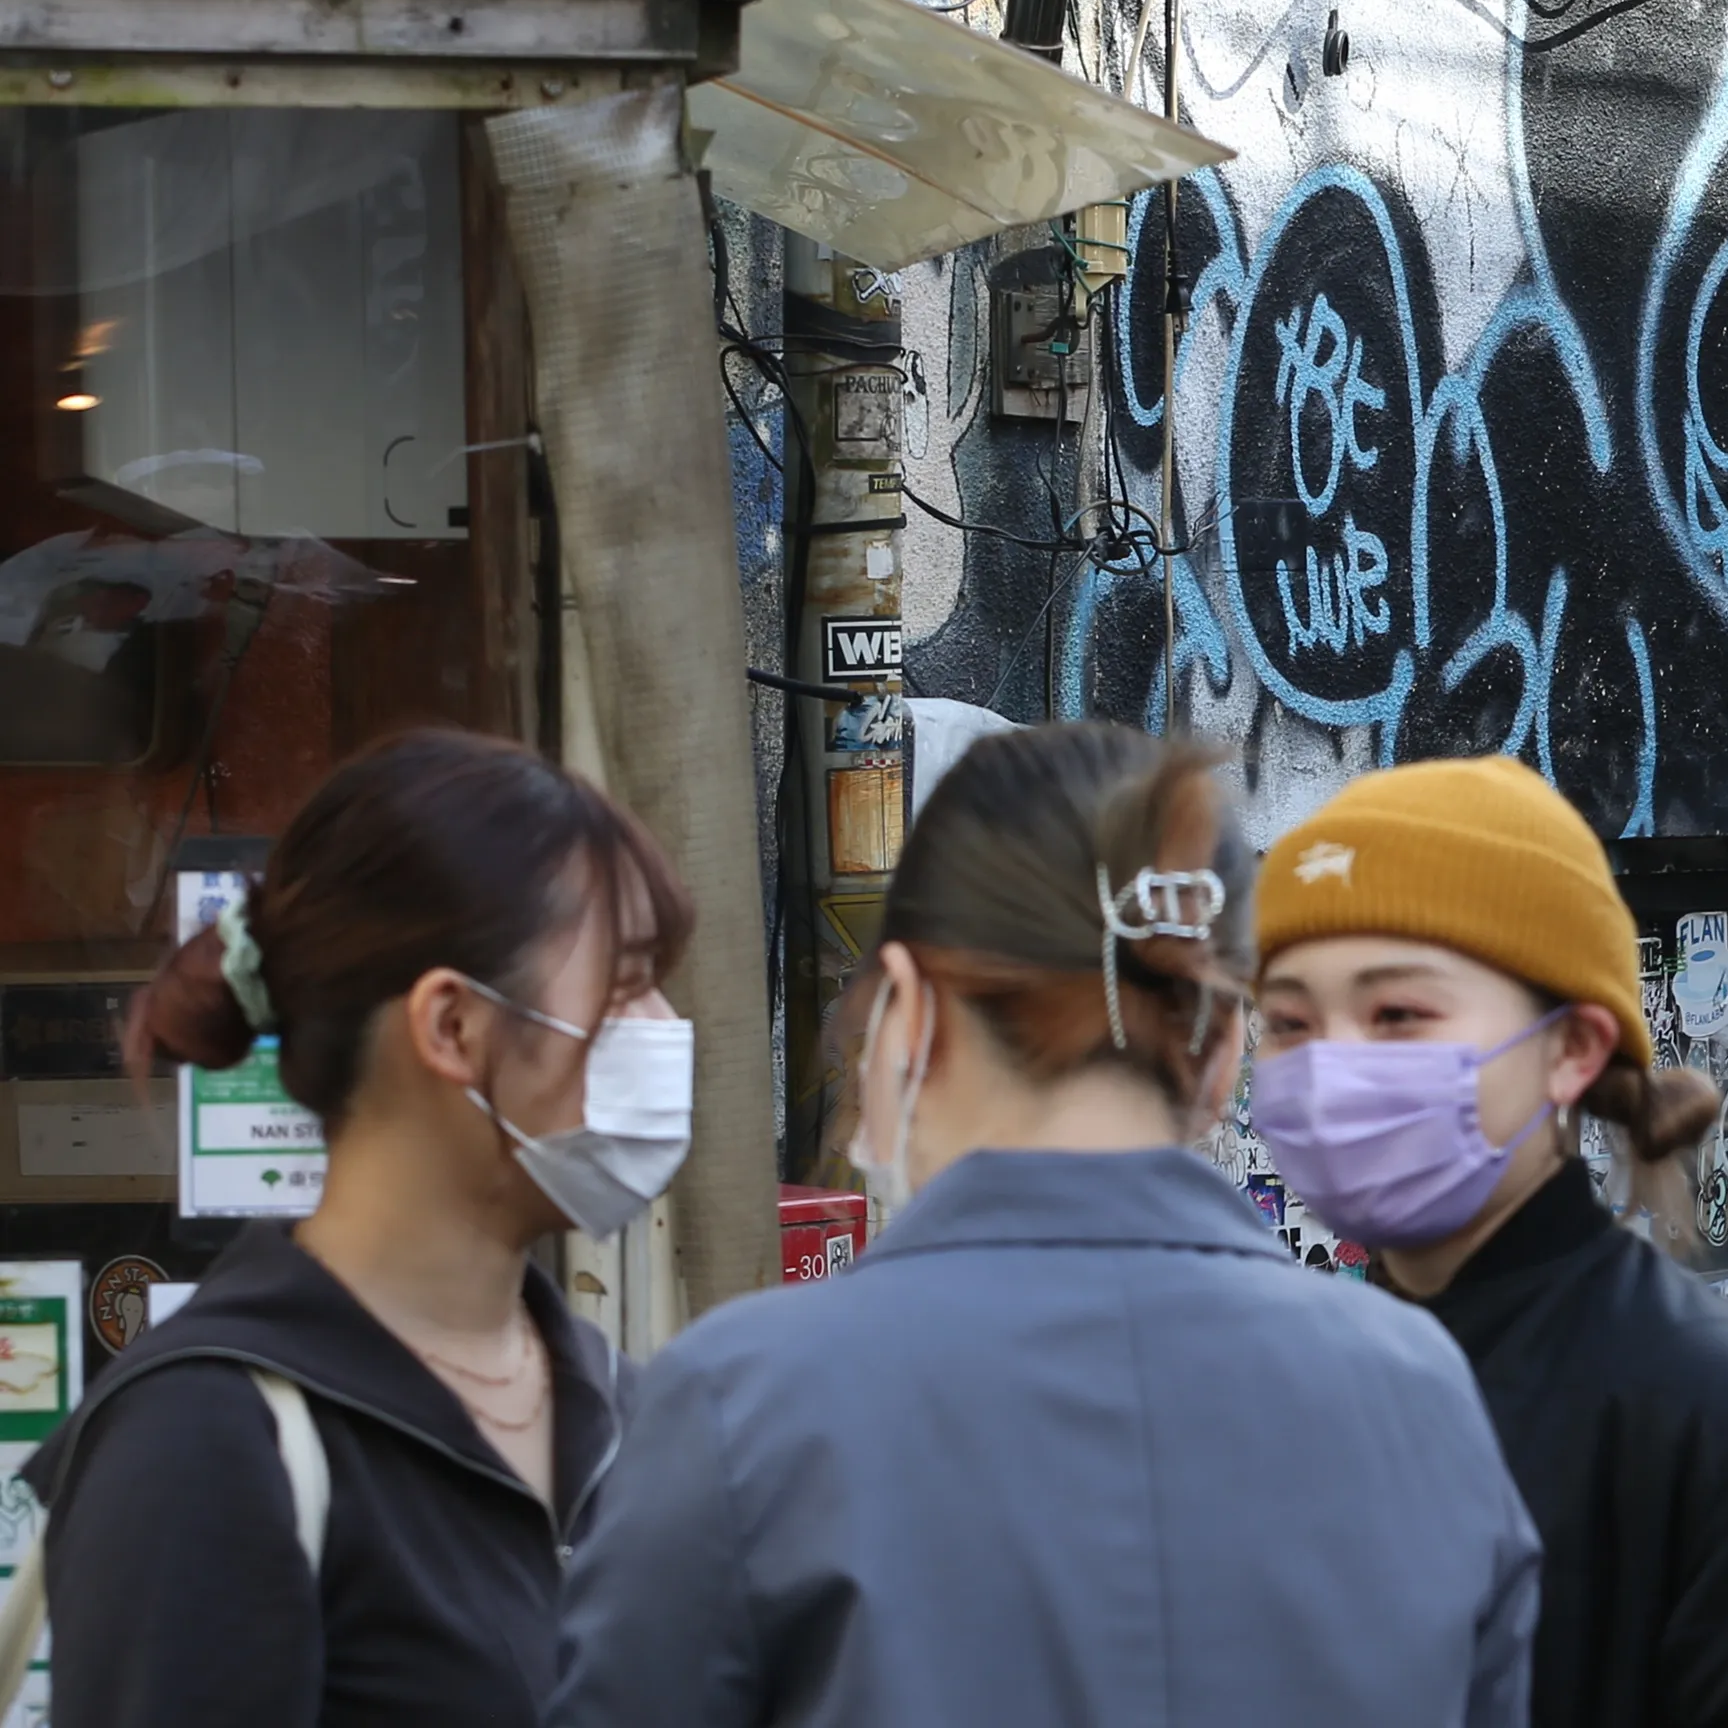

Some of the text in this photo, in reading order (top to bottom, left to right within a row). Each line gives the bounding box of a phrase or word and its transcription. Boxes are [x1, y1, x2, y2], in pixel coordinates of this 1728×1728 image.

[1680, 915, 1725, 945] FLAN
[251, 1124, 289, 1140] NAN
[100, 1267, 150, 1320] NAN STA
